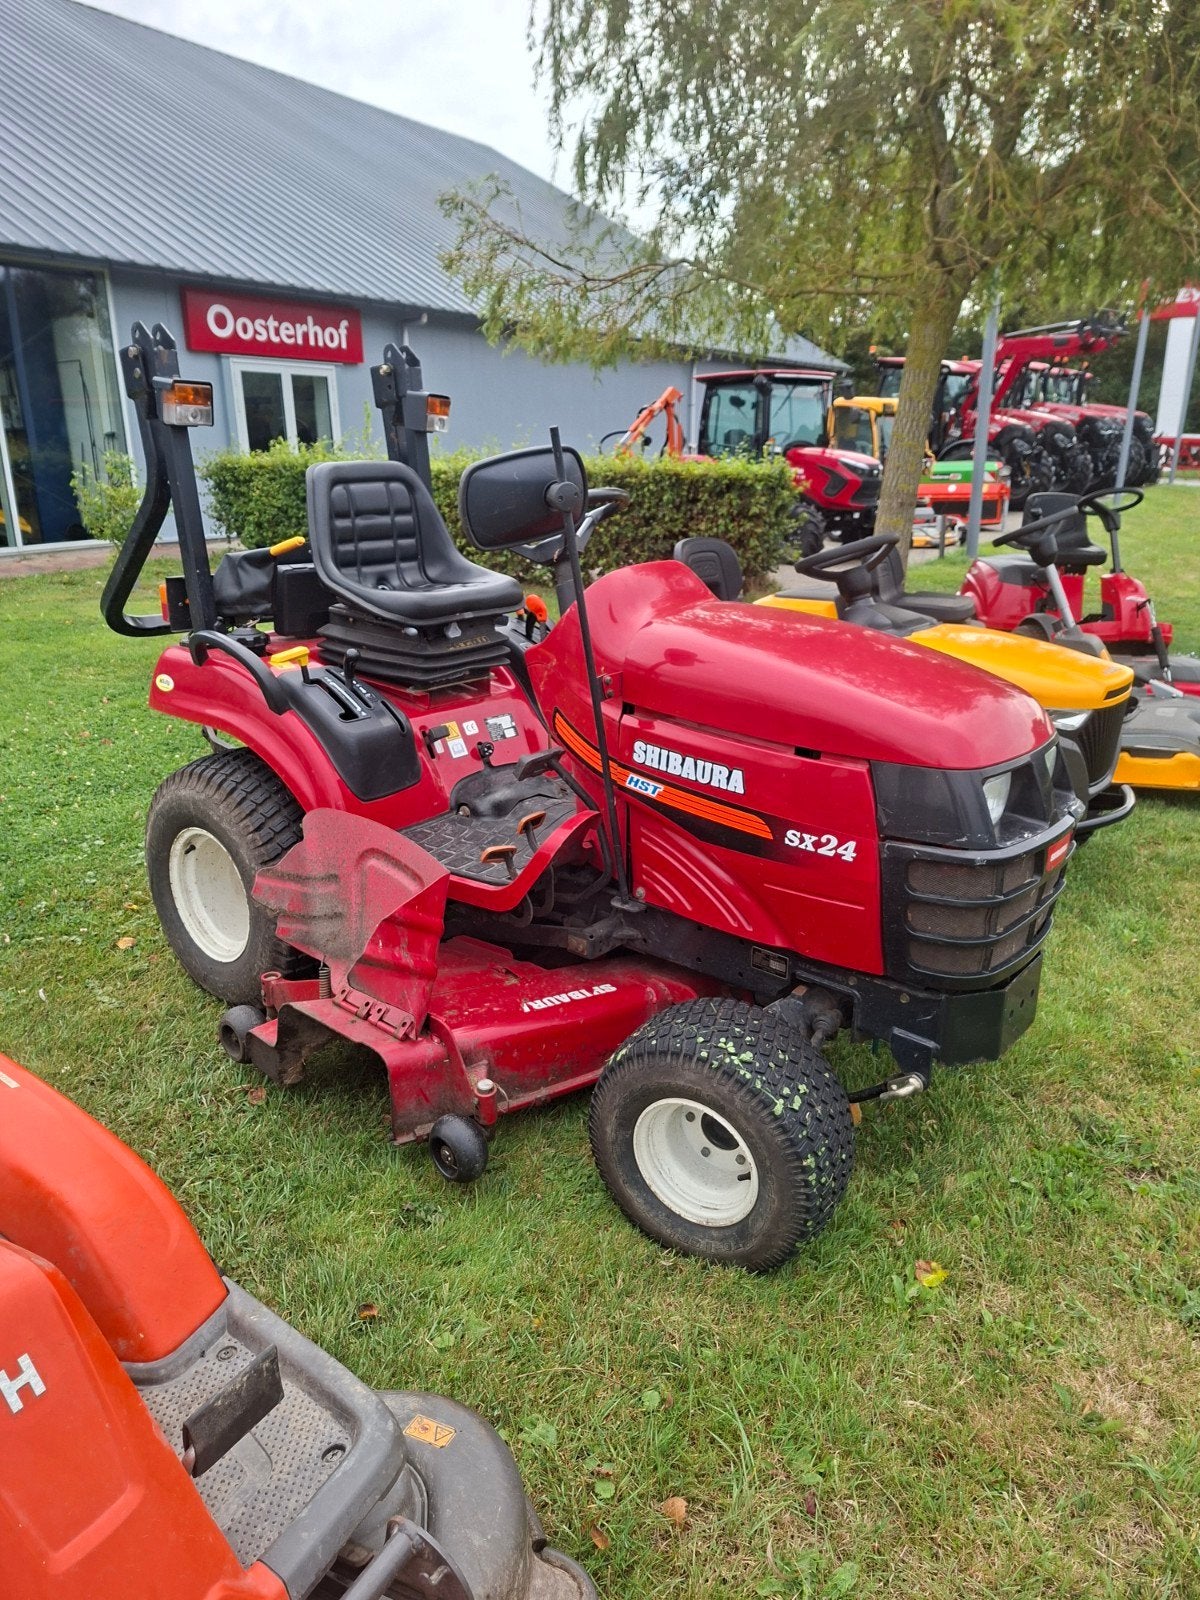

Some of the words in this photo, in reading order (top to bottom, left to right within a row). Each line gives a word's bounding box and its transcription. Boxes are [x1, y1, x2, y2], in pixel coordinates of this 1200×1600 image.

[206, 303, 349, 349] Oosterhof
[627, 775, 662, 797] HST
[632, 740, 745, 795] SHIBAURA
